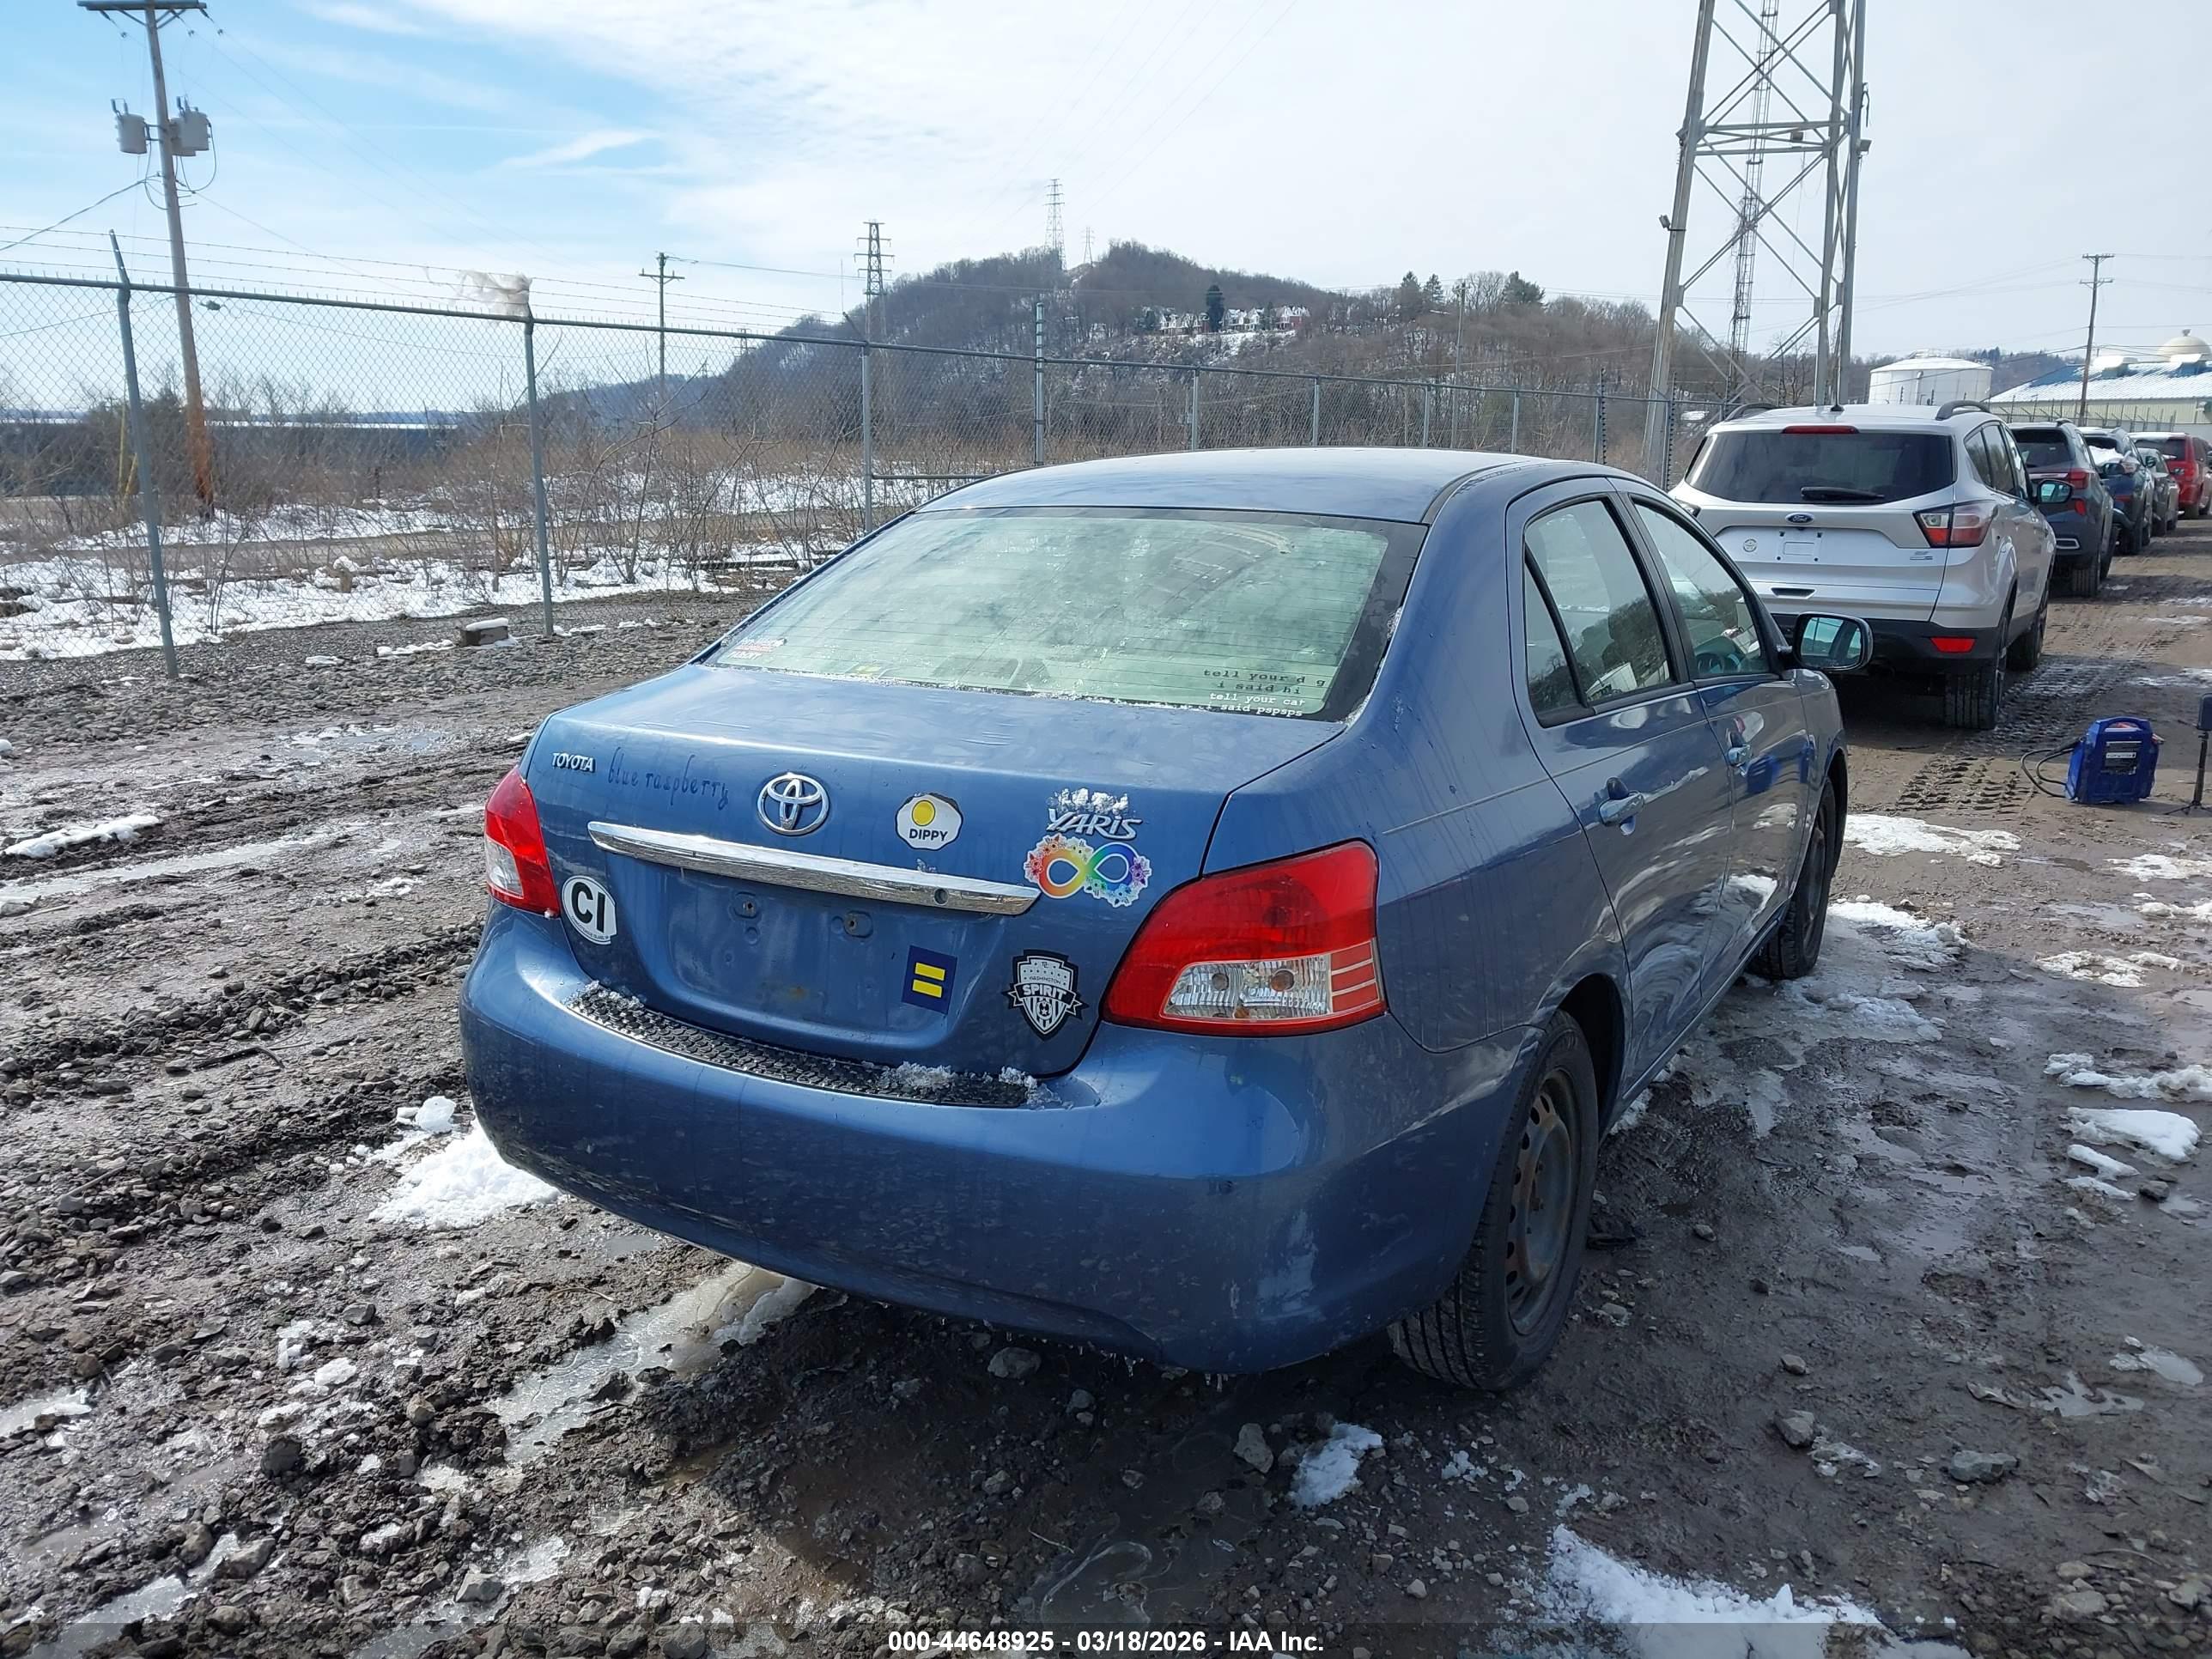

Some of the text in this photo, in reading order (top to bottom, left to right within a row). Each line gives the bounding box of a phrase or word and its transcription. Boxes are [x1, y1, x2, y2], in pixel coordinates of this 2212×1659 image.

[1204, 668, 1240, 678] tell
[1249, 672, 1289, 682] your
[1235, 683, 1275, 693] said
[1282, 686, 1301, 695] hi
[1209, 692, 1306, 707] tell your cat
[1220, 703, 1251, 713] said
[1256, 707, 1304, 717] pspsps
[551, 752, 595, 772] TOYOTA
[607, 746, 730, 811] blue raspberry
[908, 829, 948, 842] DIPPY
[571, 881, 606, 933] CI
[1022, 983, 1067, 1000] SPIRIT
